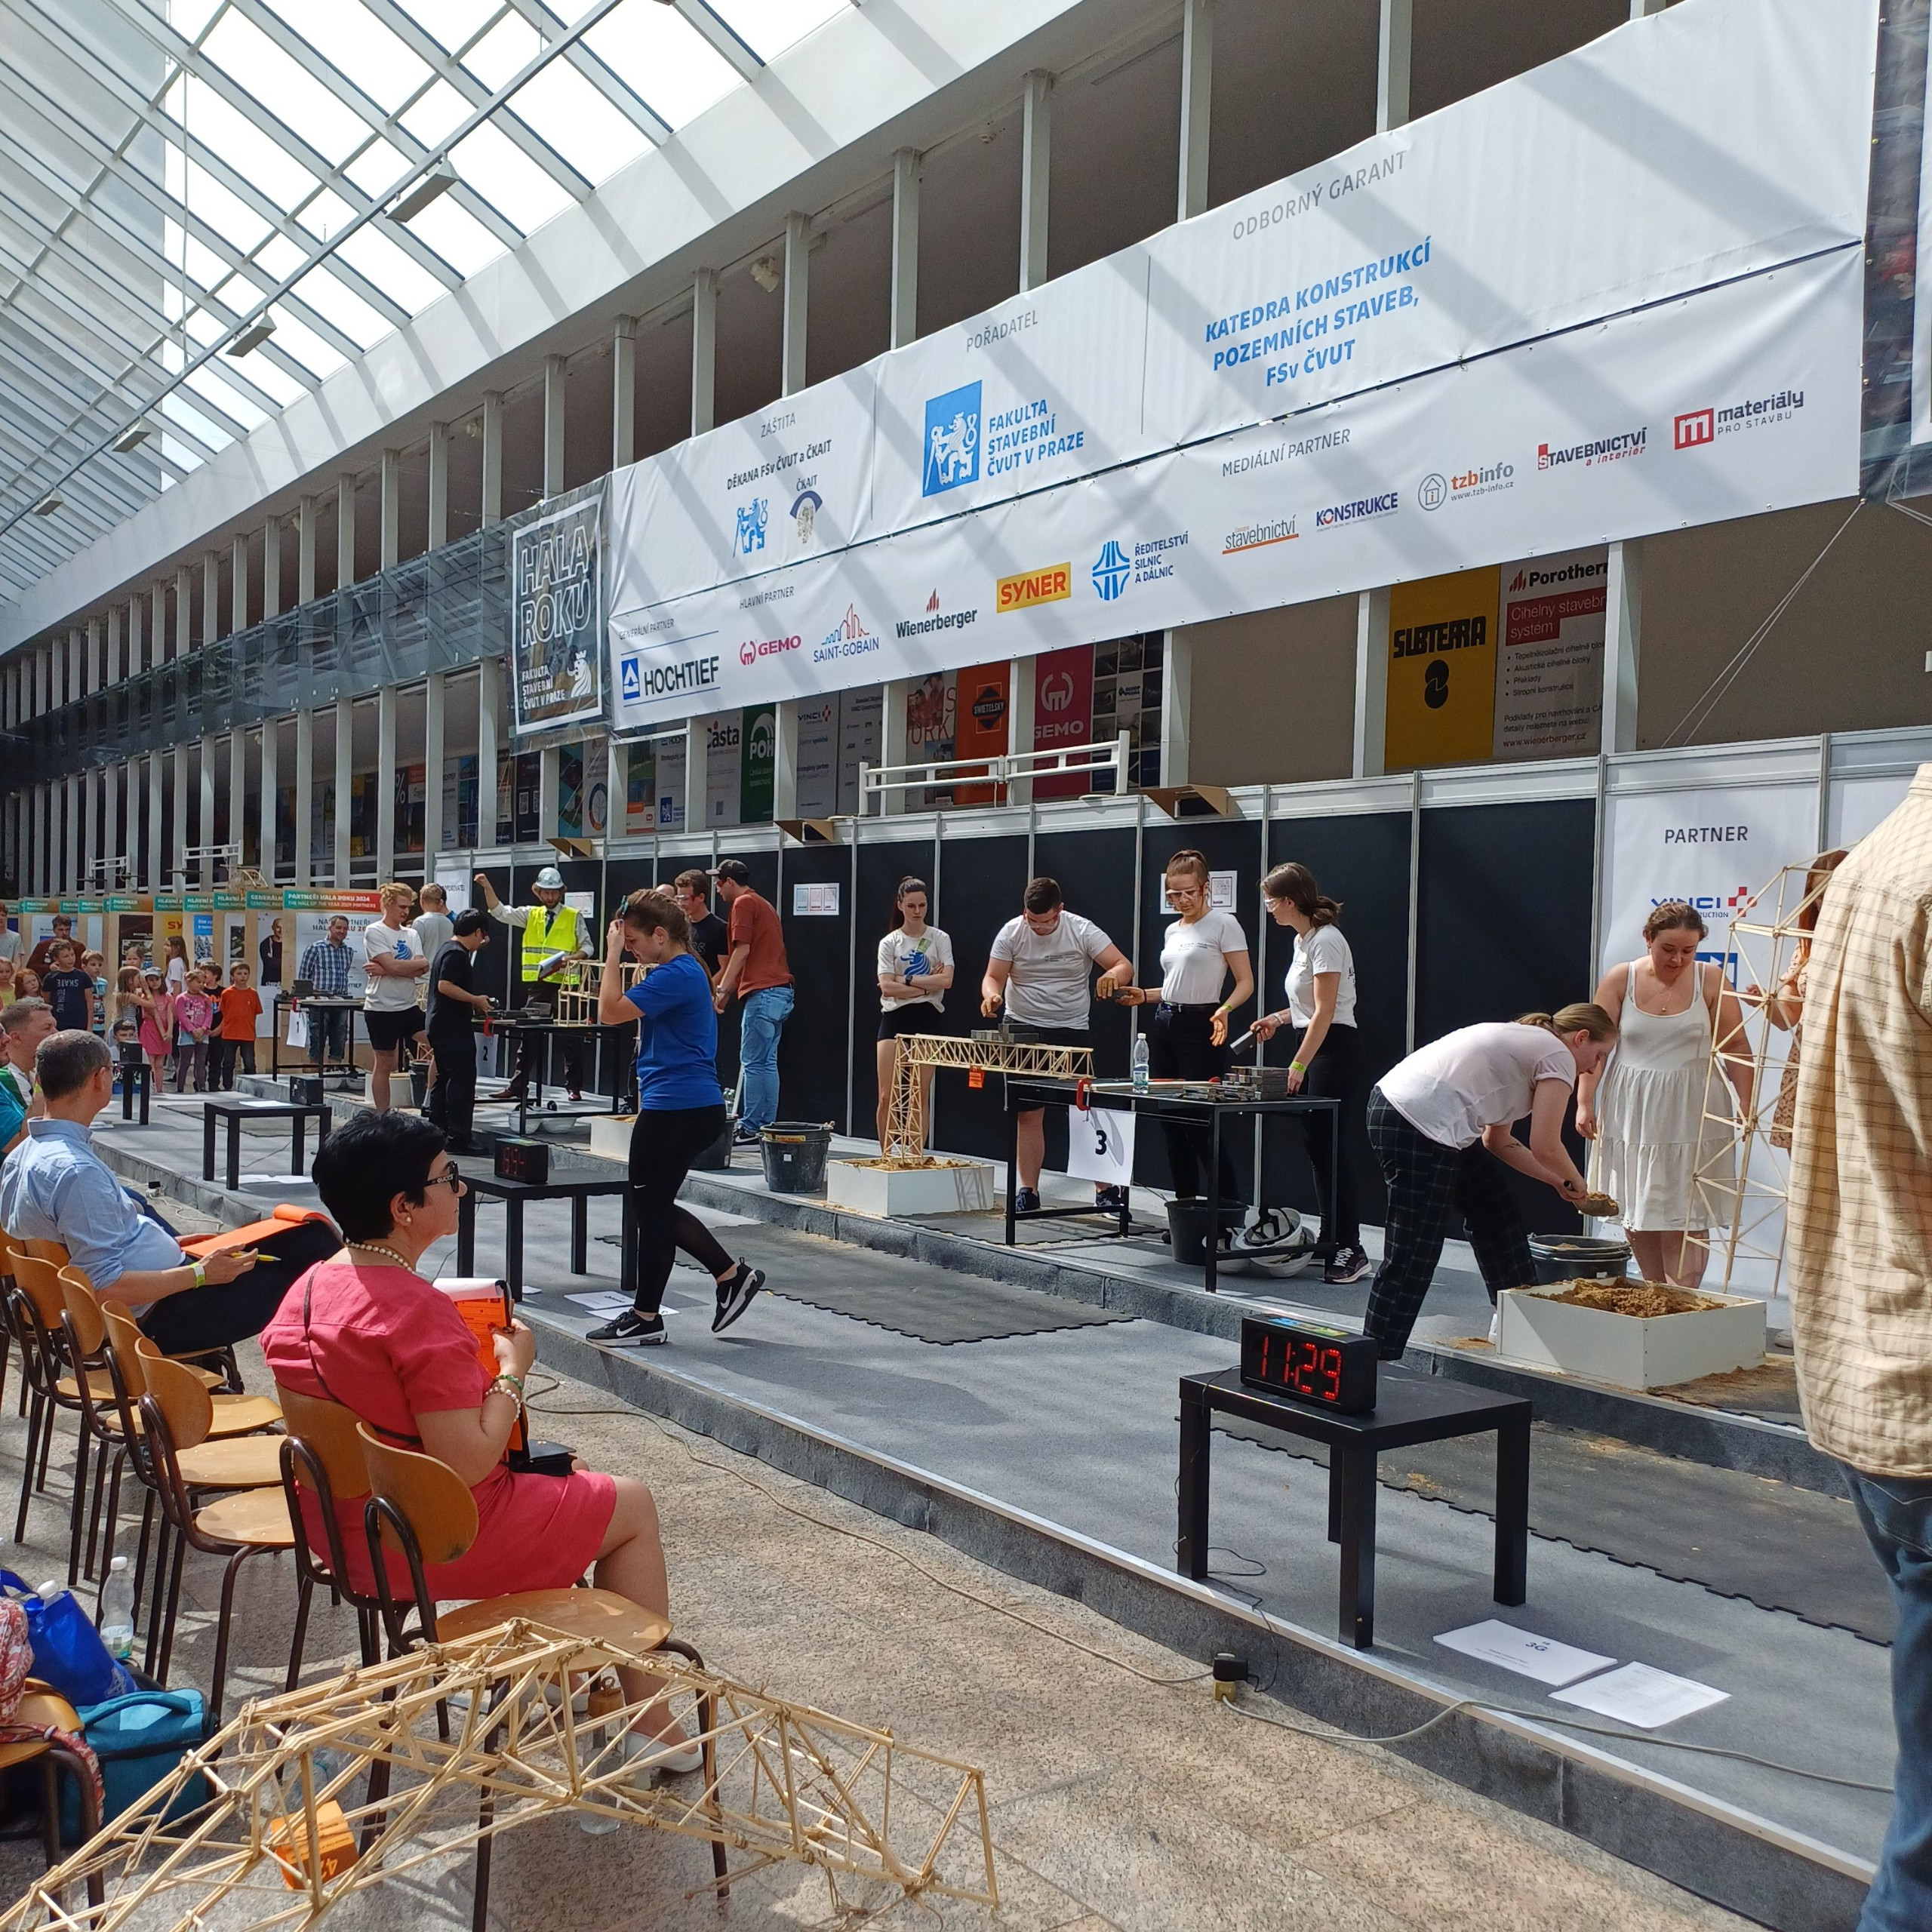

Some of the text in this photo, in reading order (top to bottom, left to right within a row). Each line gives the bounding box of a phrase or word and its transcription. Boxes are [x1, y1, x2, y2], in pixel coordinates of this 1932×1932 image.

[1232, 150, 1407, 240] ODBORNÝ GARANT
[1206, 235, 1432, 343] KATEDRA KONSTRUKCÍ
[966, 309, 1038, 352] POŘADATEL
[1213, 285, 1420, 371] POZEMNÍCH STAVEB,
[1266, 339, 1355, 387] FSv ČVUT
[989, 398, 1048, 434] FAKULTA
[1717, 389, 1804, 423] materiály
[761, 412, 796, 438] ZÁŠTITA
[988, 413, 1057, 455] STAVEBNÍ
[1718, 410, 1792, 435] PRO STAVBU
[987, 430, 1084, 477] ČVUT V PRAZE
[1222, 429, 1351, 477] MEDIÁLNÍ PARTNER
[1537, 426, 1647, 470] STAVEBNICTVÍ
[1586, 457, 1592, 467] a
[727, 468, 759, 490] DĚKANA
[776, 452, 798, 471] ČVUT
[799, 453, 804, 463] a
[807, 439, 832, 460] ČKAIT
[1451, 462, 1514, 491] tzbinfo
[796, 475, 818, 491] ČKAIT
[1451, 480, 1514, 502] www.tzb-info.cz
[1315, 491, 1398, 528] KONSTRUKCE
[1134, 531, 1189, 557] ŘEDITELSTVÍ
[1225, 514, 1297, 550] stavebnictví
[521, 525, 589, 596] HALA
[1134, 554, 1162, 571] SILNIC
[1134, 565, 1174, 583] A DÁLNIC
[739, 586, 795, 610] HLAVNÍ PARTNER
[1001, 571, 1066, 605] SYNER
[521, 578, 591, 649] ROKU
[649, 618, 675, 633] PARTNER
[897, 608, 978, 639] Wienerberger
[1511, 603, 1555, 622] Cihelný
[1393, 616, 1486, 658] SUBTERRA
[1510, 620, 1553, 640] systém
[758, 635, 801, 657] GEMO
[813, 636, 879, 663] SAINT-GOBAIN
[522, 665, 549, 682] FAKULTA
[522, 675, 553, 697] STAVEBNÍ
[644, 655, 719, 696] HOCHTIEF
[523, 690, 565, 710] ČVUT V PRAZE
[1664, 826, 1749, 844] PARTNER
[483, 1045, 488, 1061] 2
[1095, 1130, 1107, 1155] 3
[1260, 1335, 1343, 1401] 11:29
